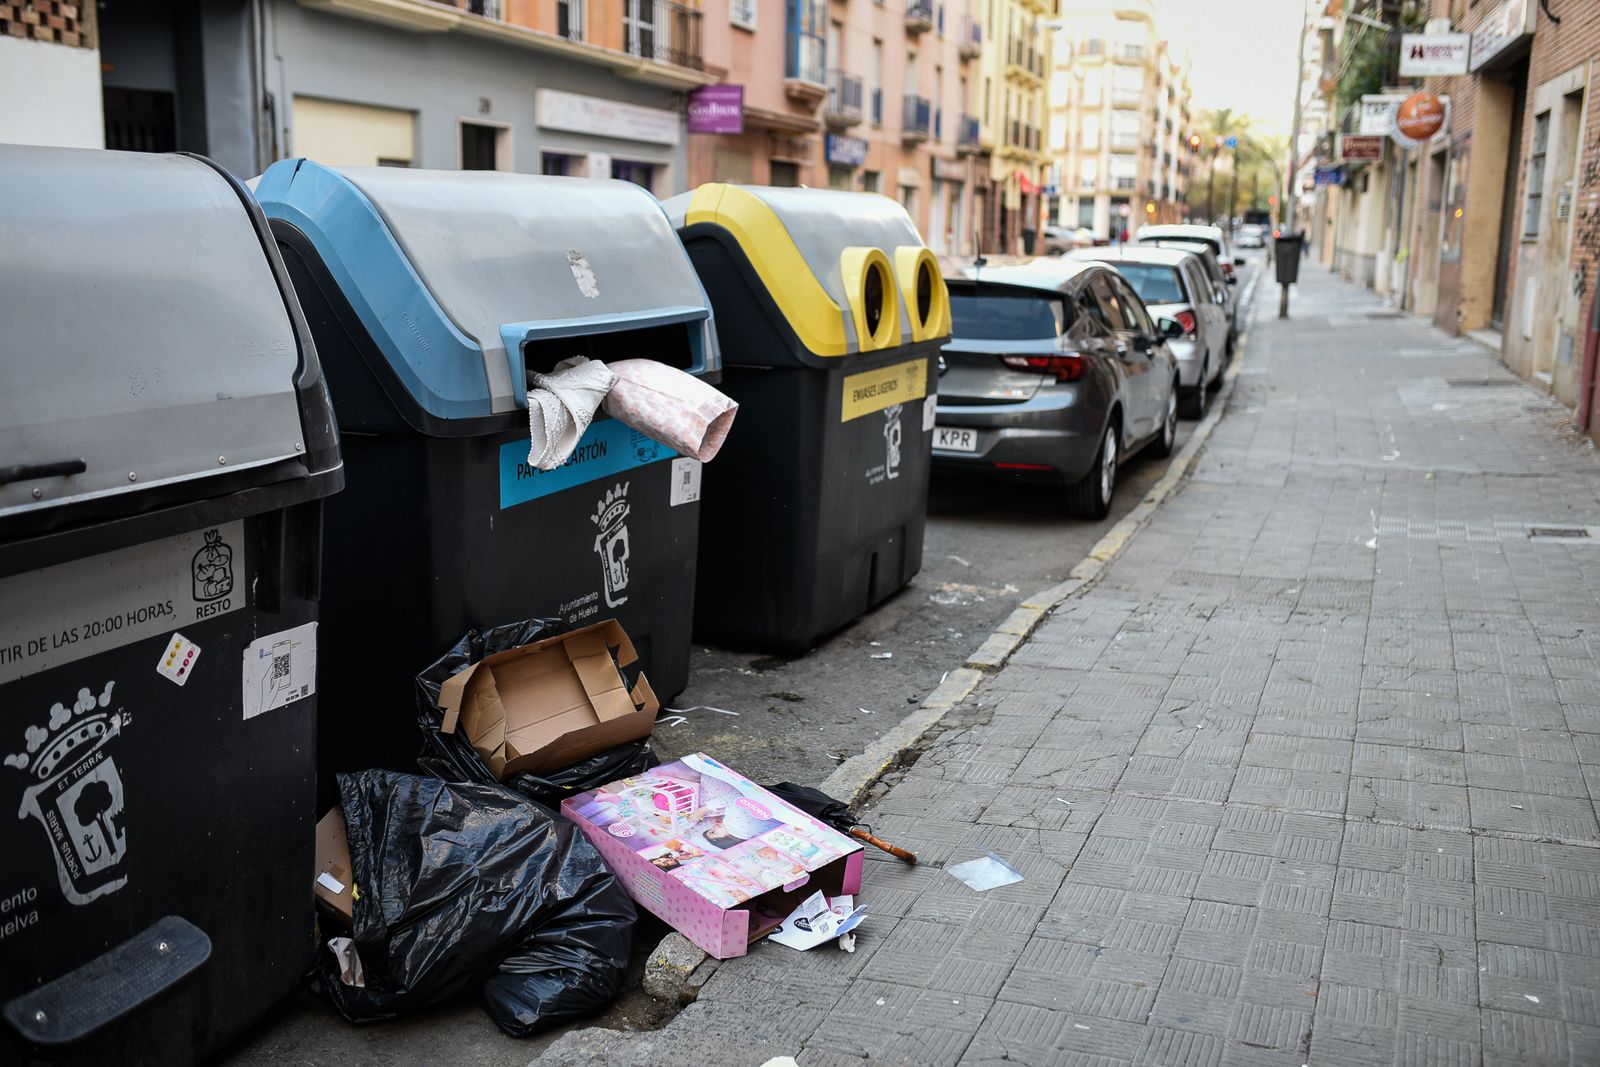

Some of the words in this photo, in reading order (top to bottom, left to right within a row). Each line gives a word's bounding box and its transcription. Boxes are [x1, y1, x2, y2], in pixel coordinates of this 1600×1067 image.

[940, 430, 971, 447] KPR
[196, 598, 231, 620] RESTO
[559, 591, 598, 615] Ayuntamiento
[569, 611, 577, 623] de
[578, 605, 598, 620] Huelva
[28, 637, 48, 657] DE
[52, 628, 79, 649] LAS
[83, 615, 122, 640] 20:00
[127, 600, 174, 626] HORAS
[57, 778, 69, 791] ET
[46, 809, 63, 841] MARIS
[61, 841, 80, 880] PORTUS
